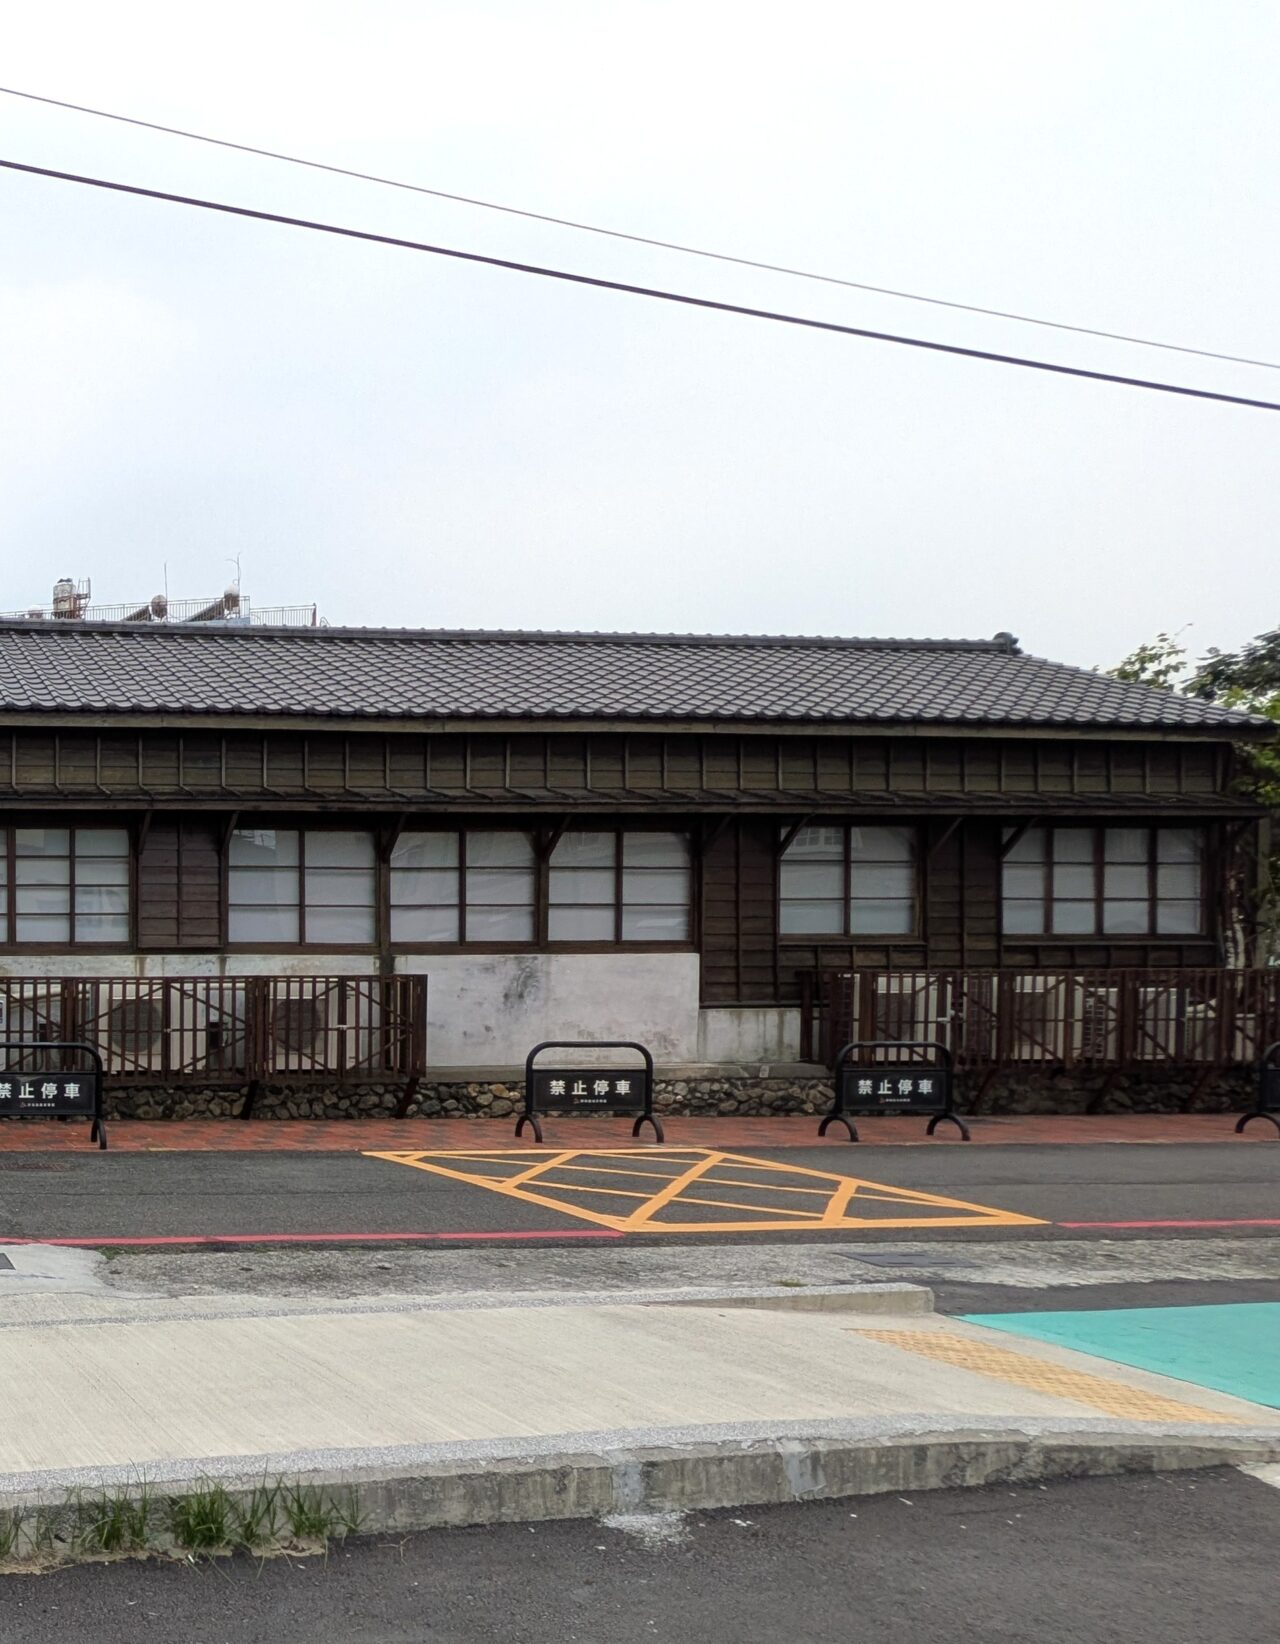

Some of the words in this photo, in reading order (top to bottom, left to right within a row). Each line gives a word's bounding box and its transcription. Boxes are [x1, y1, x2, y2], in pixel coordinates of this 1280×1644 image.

[549, 1080, 632, 1096] 禁止停車
[858, 1079, 933, 1095] 禁止停車
